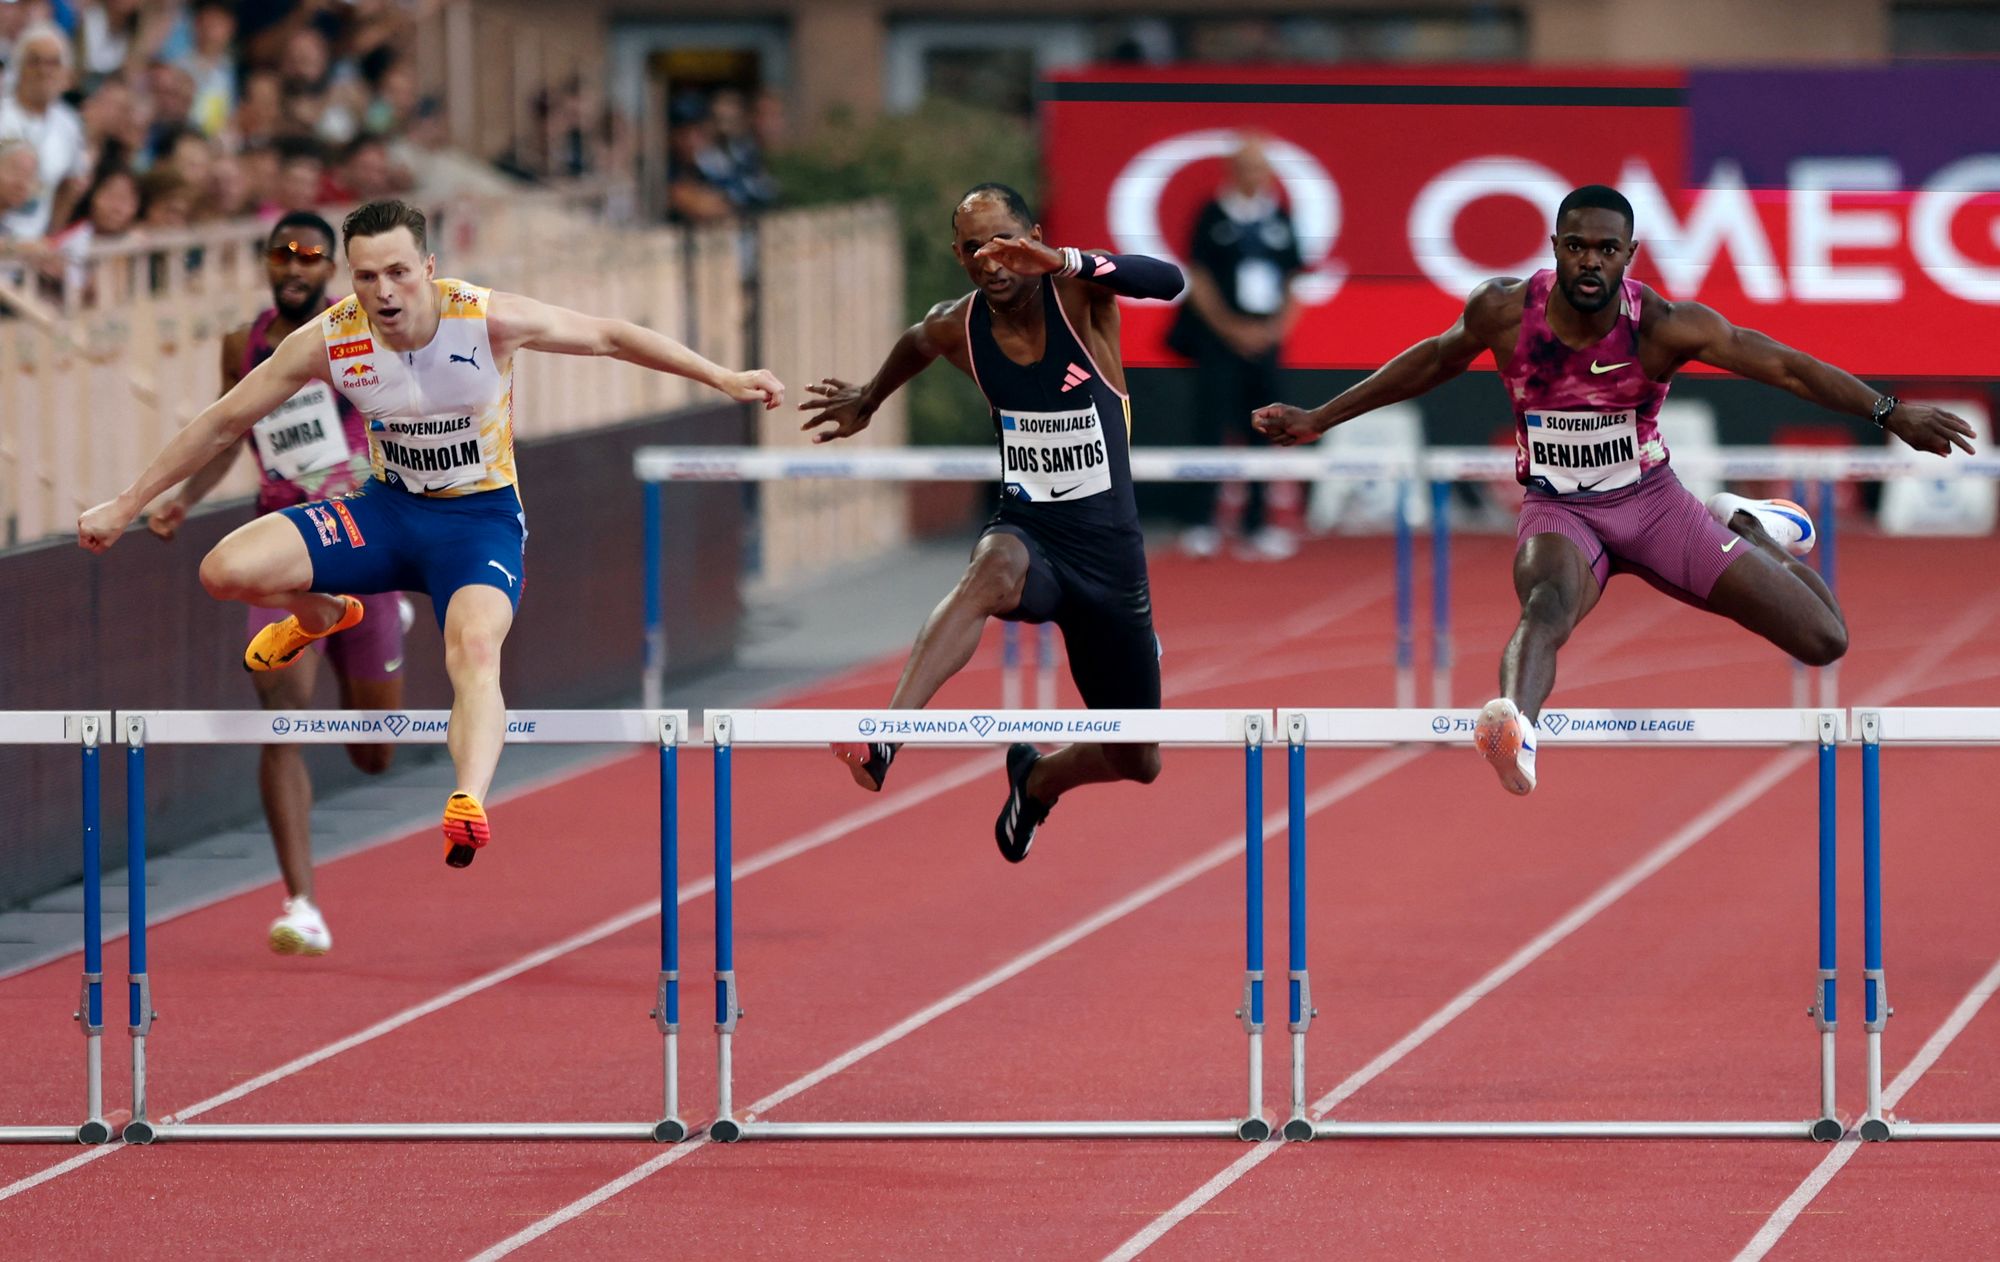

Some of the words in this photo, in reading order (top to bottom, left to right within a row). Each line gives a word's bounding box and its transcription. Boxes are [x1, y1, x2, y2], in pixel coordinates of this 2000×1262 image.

[346, 344, 368, 353] EXTRA
[343, 378, 361, 389] Red
[361, 375, 379, 386] Bull
[389, 416, 471, 436] SLOVENIJALES
[1019, 414, 1096, 433] SLOVENIJALES
[1546, 413, 1627, 431] SLOVENIJALES
[269, 418, 325, 456] SAMBA
[381, 439, 480, 471] WARHOLM
[1007, 445, 1039, 472] DOS
[1042, 440, 1104, 473] SANTOS
[1533, 436, 1634, 468] BENJAMIN
[412, 721, 448, 732] DIAM
[998, 720, 1063, 732] DIAMOND
[1067, 720, 1121, 732] LEAGUE
[1571, 720, 1636, 731] DIAMOND
[1641, 720, 1695, 731] LEAGUE
